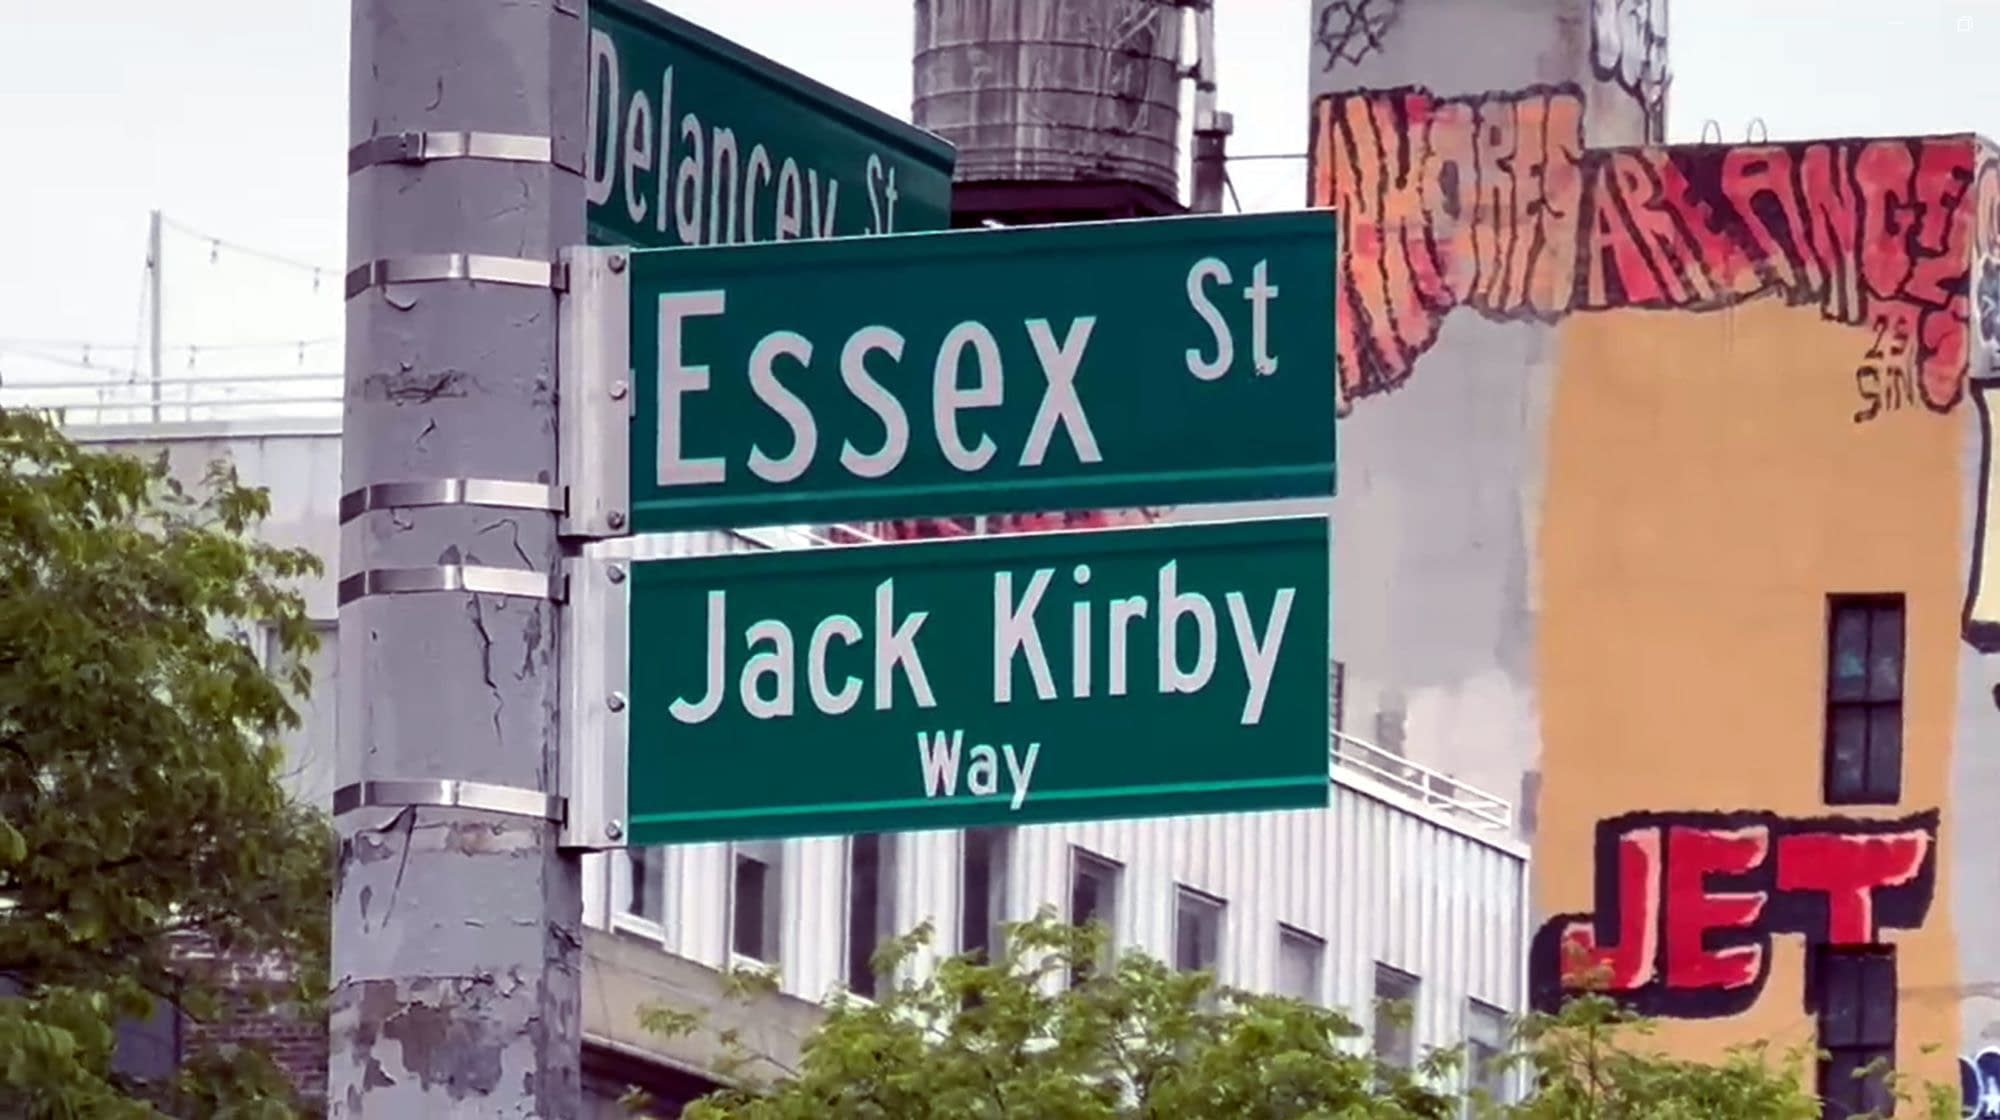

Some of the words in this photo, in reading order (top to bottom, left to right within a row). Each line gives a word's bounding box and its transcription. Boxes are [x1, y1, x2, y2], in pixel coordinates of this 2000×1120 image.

[586, 28, 838, 246] Delancey
[865, 153, 898, 236] St
[1586, 148, 1760, 308] ARE
[656, 289, 1103, 486] Essex
[1186, 257, 1279, 380] St
[667, 577, 937, 724] Jack
[993, 559, 1296, 724] Kirby
[917, 729, 1041, 809] Way
[1532, 810, 1938, 1014] JET
